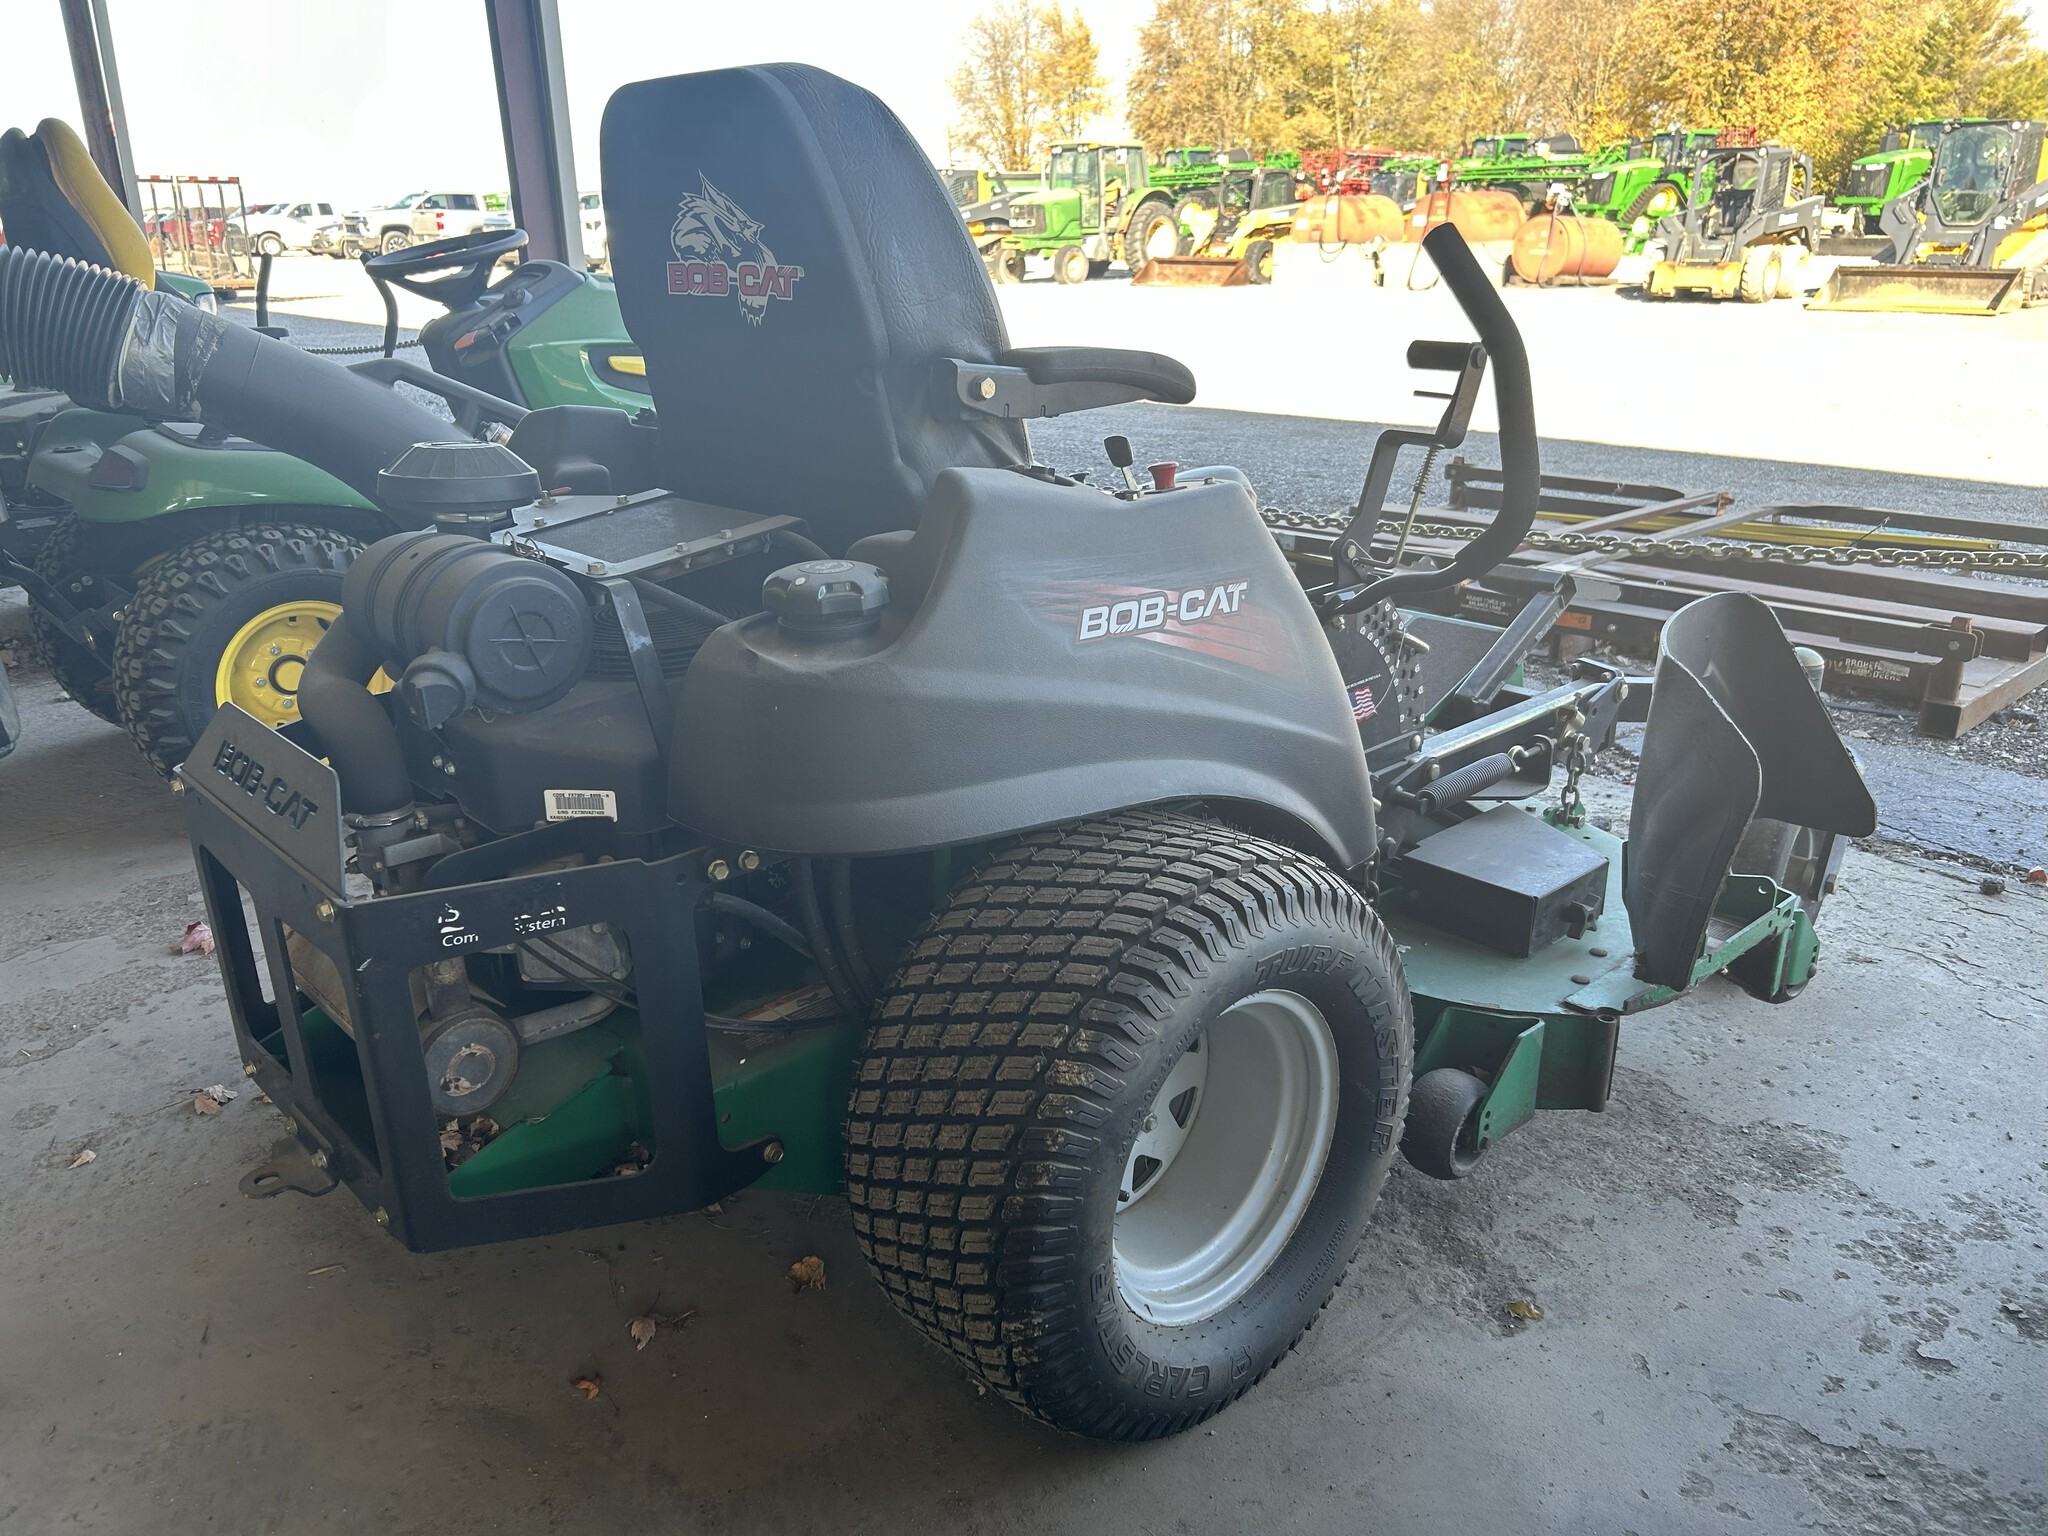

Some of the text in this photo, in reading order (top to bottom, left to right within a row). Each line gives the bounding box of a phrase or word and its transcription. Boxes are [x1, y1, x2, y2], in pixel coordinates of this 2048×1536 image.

[667, 261, 800, 300] BOB-CAT
[1077, 580, 1250, 642] BOB-CAT
[212, 739, 319, 832] BOB-CAT
[1255, 944, 1399, 1158] TURF MASTER
